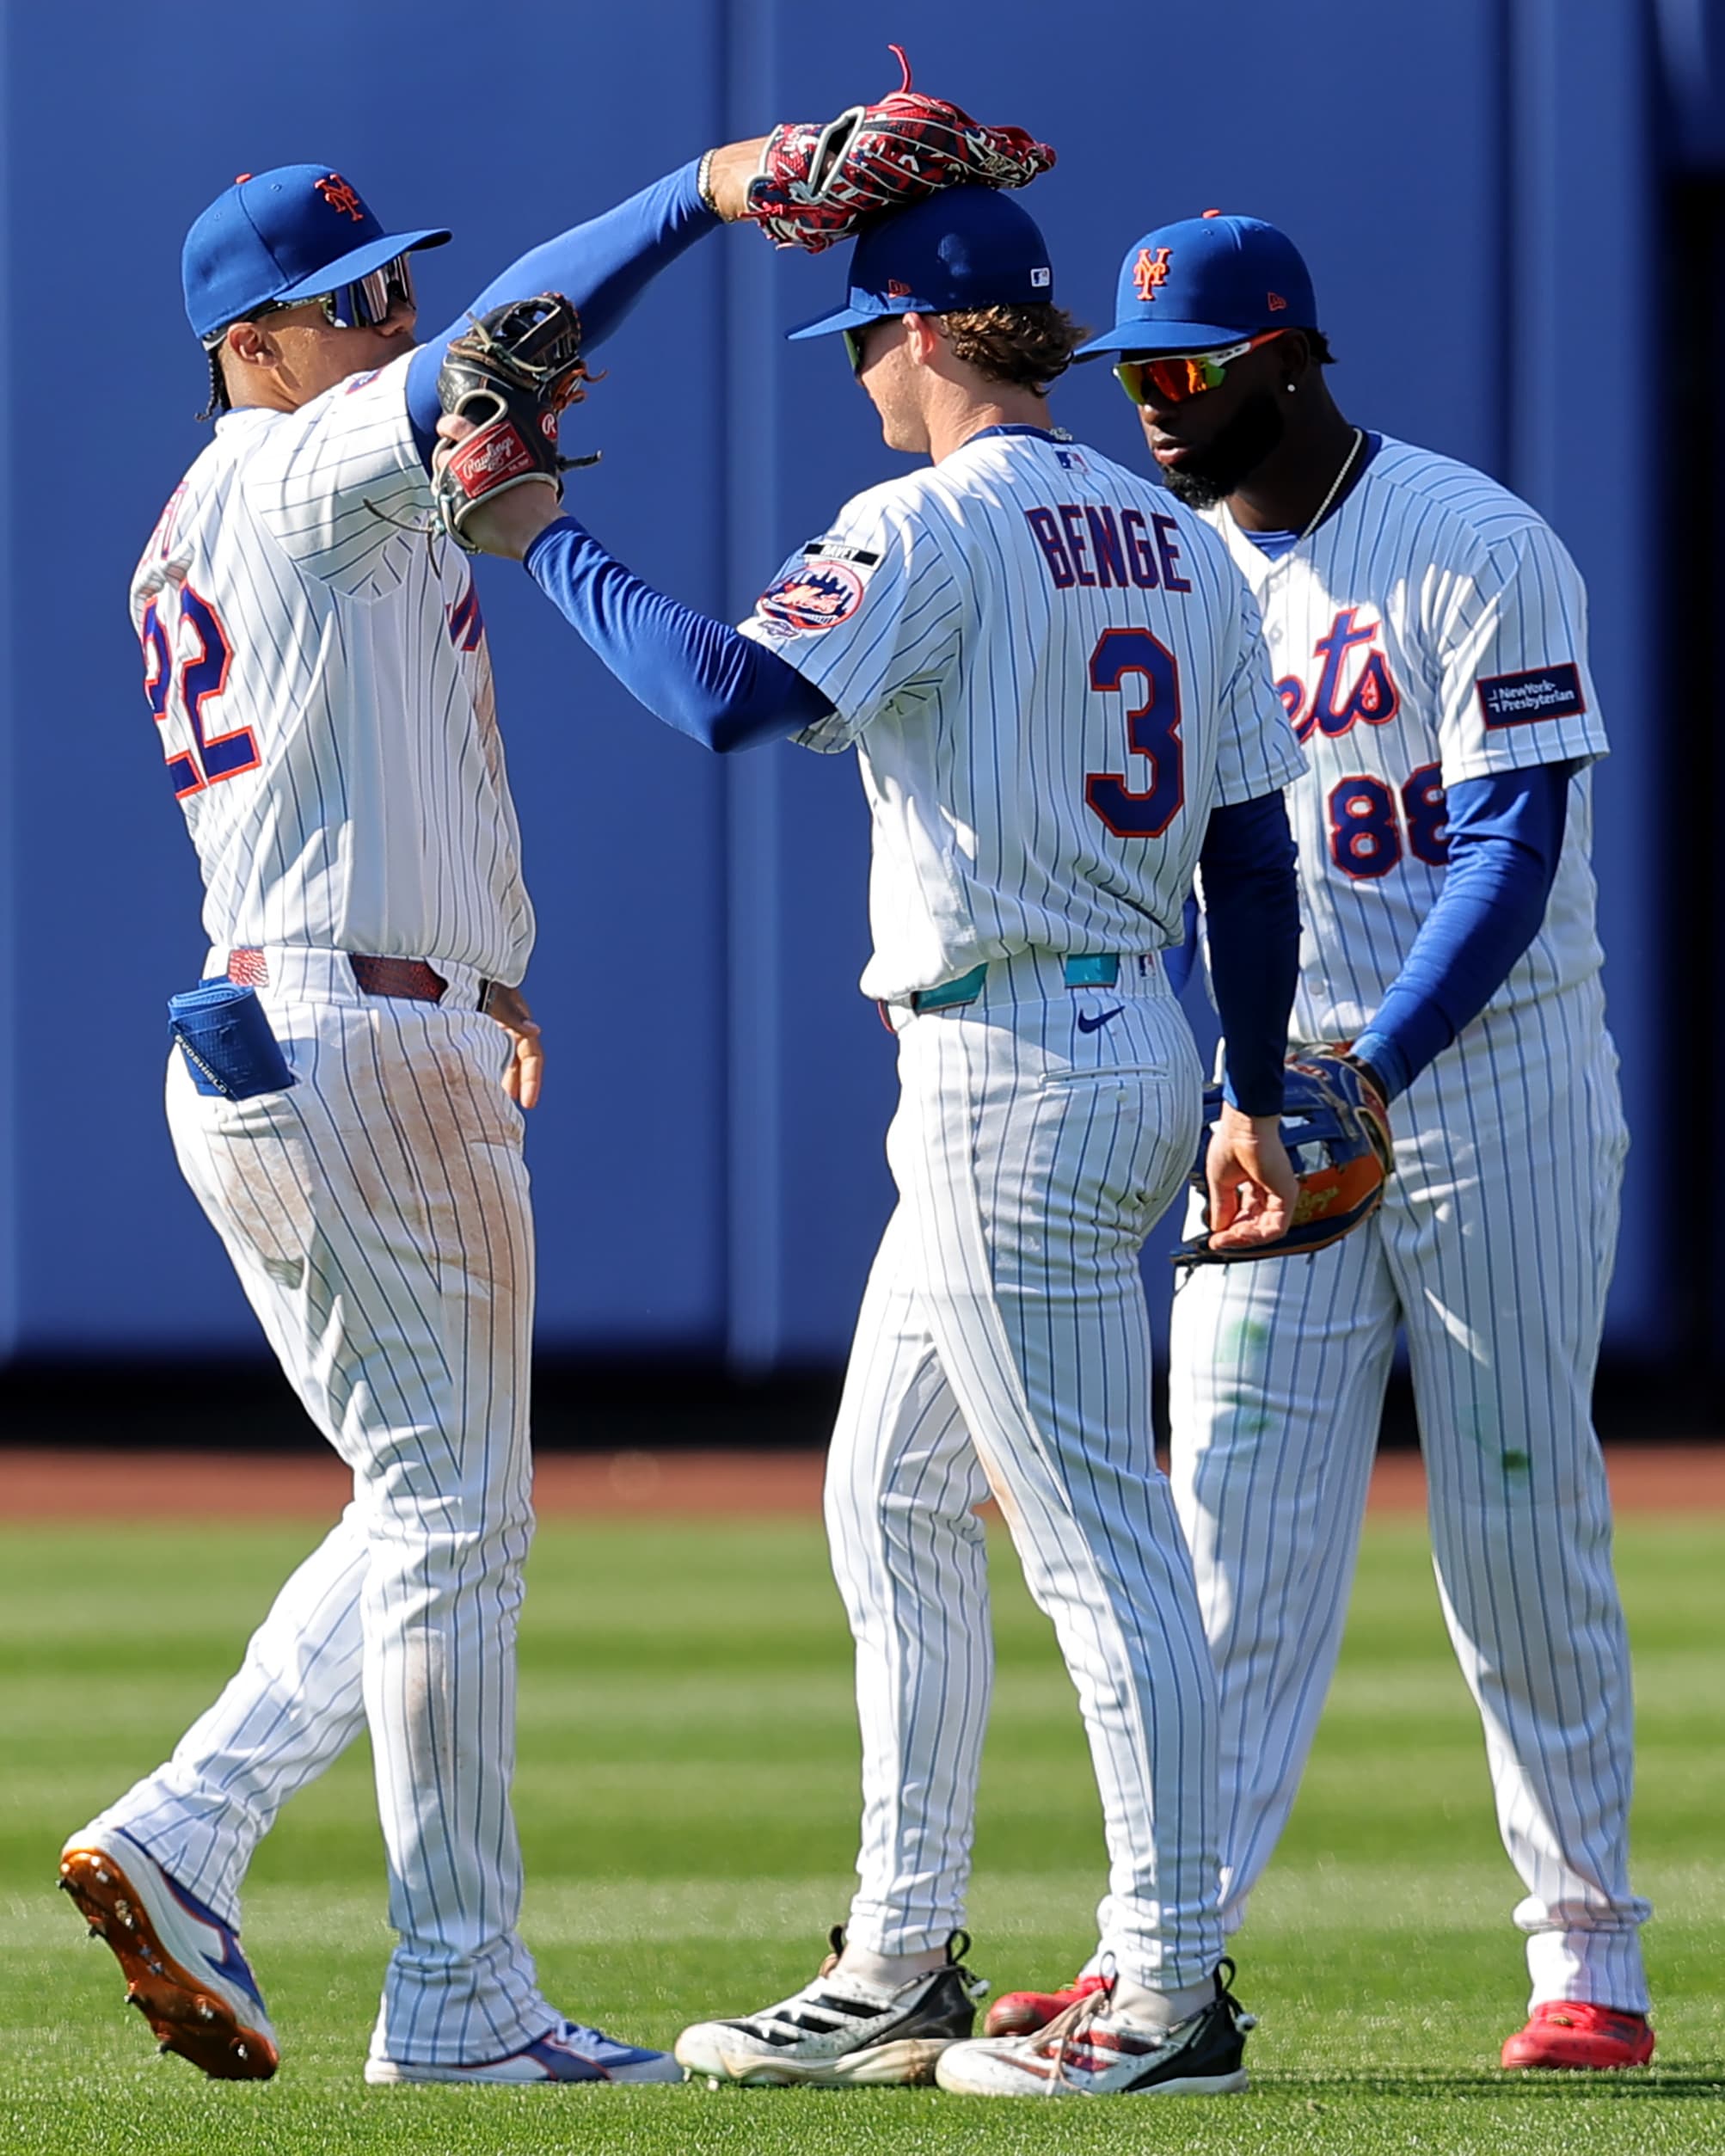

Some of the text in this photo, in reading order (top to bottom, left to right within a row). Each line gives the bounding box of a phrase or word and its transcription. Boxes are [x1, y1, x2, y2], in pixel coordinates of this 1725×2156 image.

[462, 436, 514, 480] Rawlings
[1024, 504, 1193, 593] BENGE
[143, 578, 262, 801] 22
[1085, 627, 1184, 838] 3
[1274, 607, 1400, 744] ets
[1501, 689, 1575, 712] Presbyterian
[1328, 761, 1453, 880] 88
